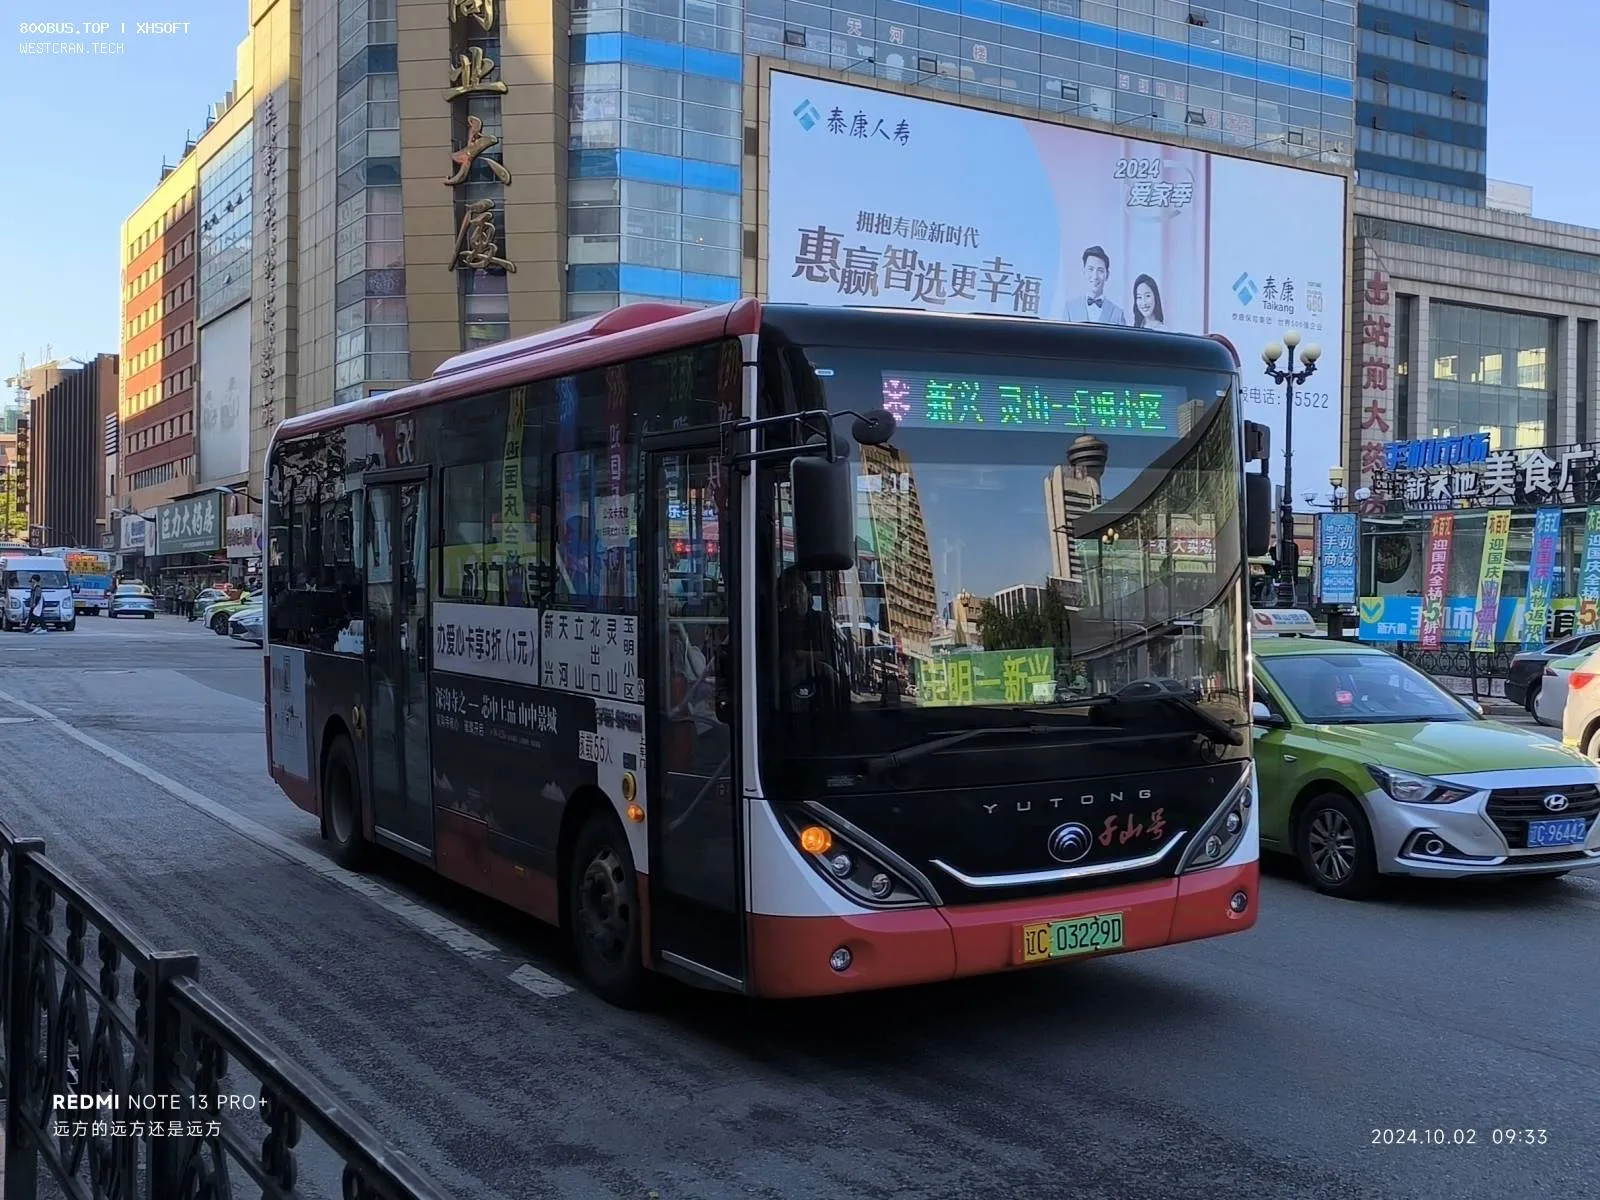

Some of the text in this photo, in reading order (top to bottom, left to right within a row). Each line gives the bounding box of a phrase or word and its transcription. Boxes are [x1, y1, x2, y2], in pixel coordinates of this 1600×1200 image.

[827, 106, 911, 146] 泰康人寿
[1113, 158, 1161, 179] 2024
[1127, 182, 1194, 208] 爱家季
[856, 210, 981, 249] 拥抱寿险新时代
[791, 225, 1043, 314] 惠赢智选更幸福
[1263, 274, 1295, 302] 泰康
[1263, 301, 1295, 315] Taikang
[1484, 443, 1600, 496] 美食广
[574, 616, 585, 690] 立山
[623, 617, 635, 700] 玉明小区
[983, 789, 1152, 814] YUTONG
